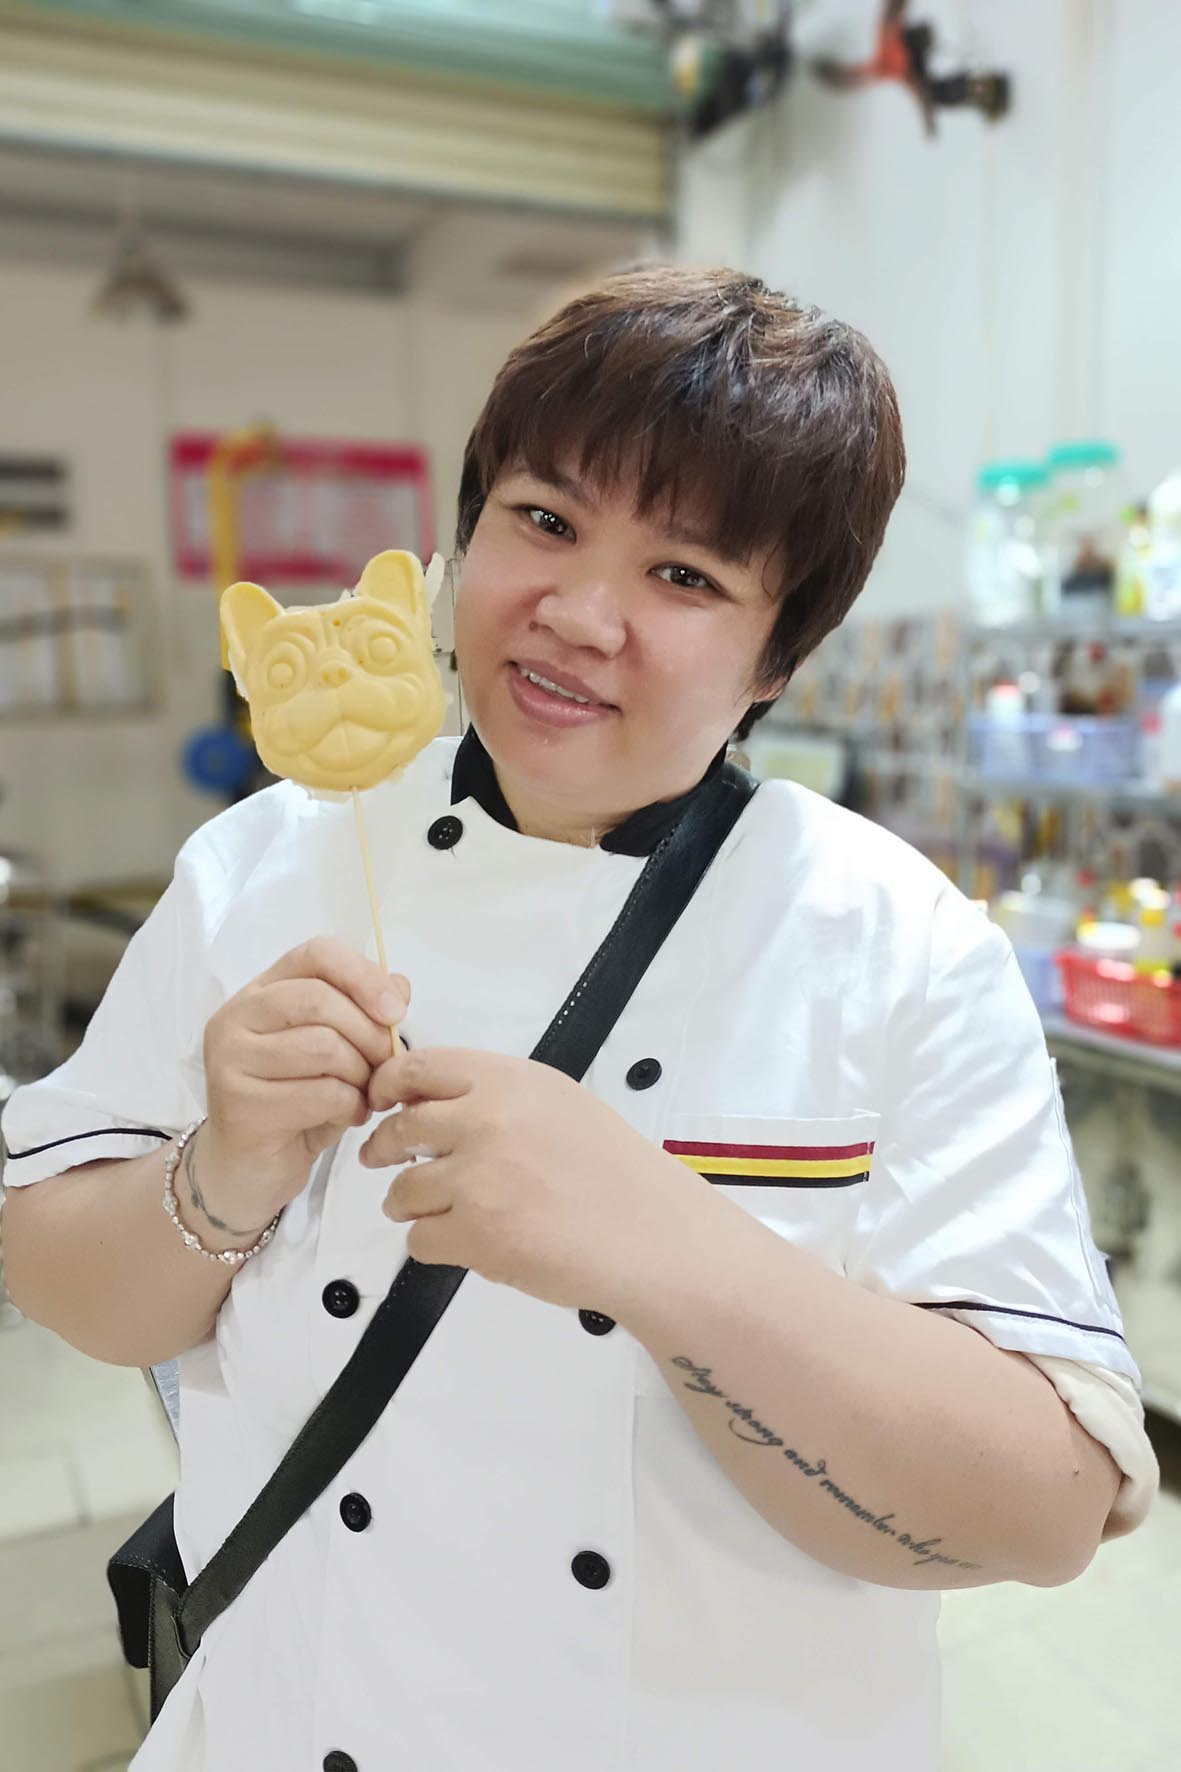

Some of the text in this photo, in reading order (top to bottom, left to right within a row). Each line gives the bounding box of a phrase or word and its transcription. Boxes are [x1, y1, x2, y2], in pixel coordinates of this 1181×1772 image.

[725, 1401, 784, 1446] strong
[783, 1449, 827, 1477] and
[819, 1479, 896, 1536] remember
